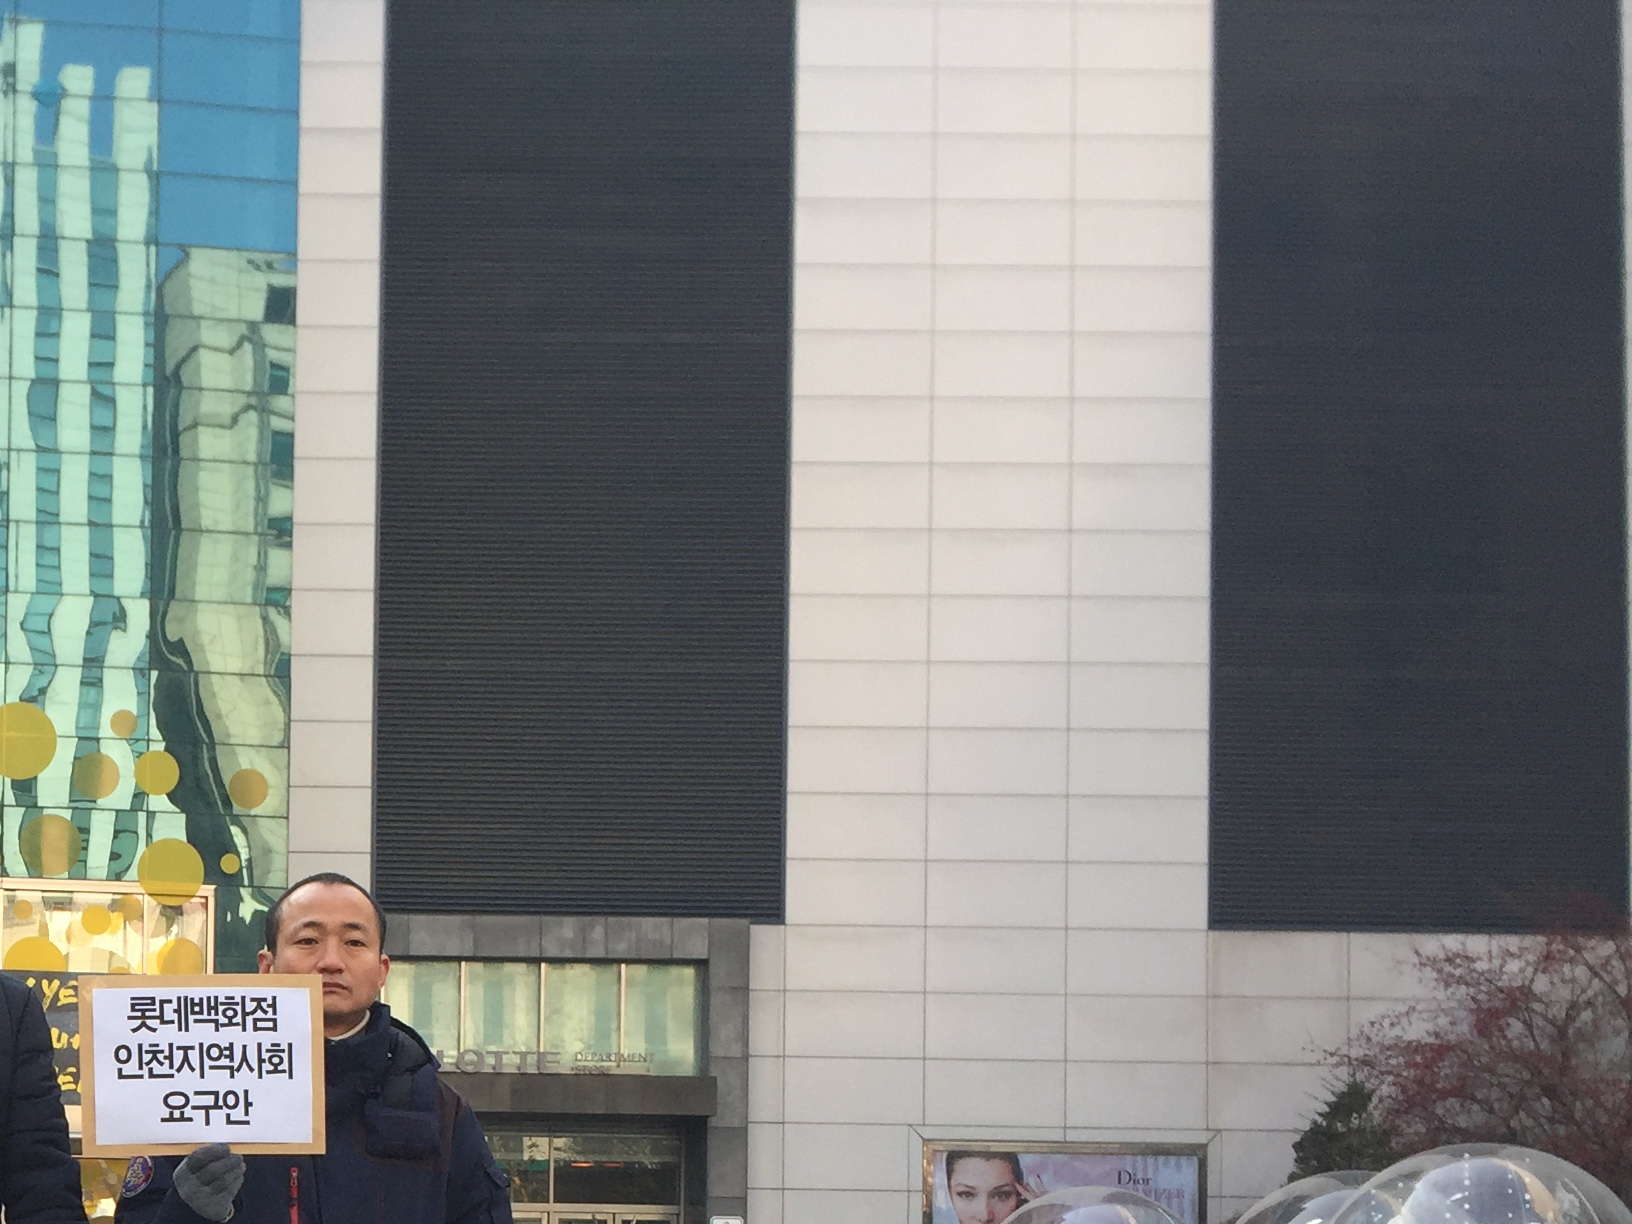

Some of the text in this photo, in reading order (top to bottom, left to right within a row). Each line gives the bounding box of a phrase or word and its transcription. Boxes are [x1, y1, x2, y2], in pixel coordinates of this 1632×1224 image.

[127, 996, 278, 1033] 롯데백화점
[113, 1042, 294, 1080] 인천지역사회
[437, 1049, 654, 1073] LOTTE DEPARTMENT
[160, 1089, 253, 1126] 요구안
[1117, 1169, 1152, 1186] Dior
